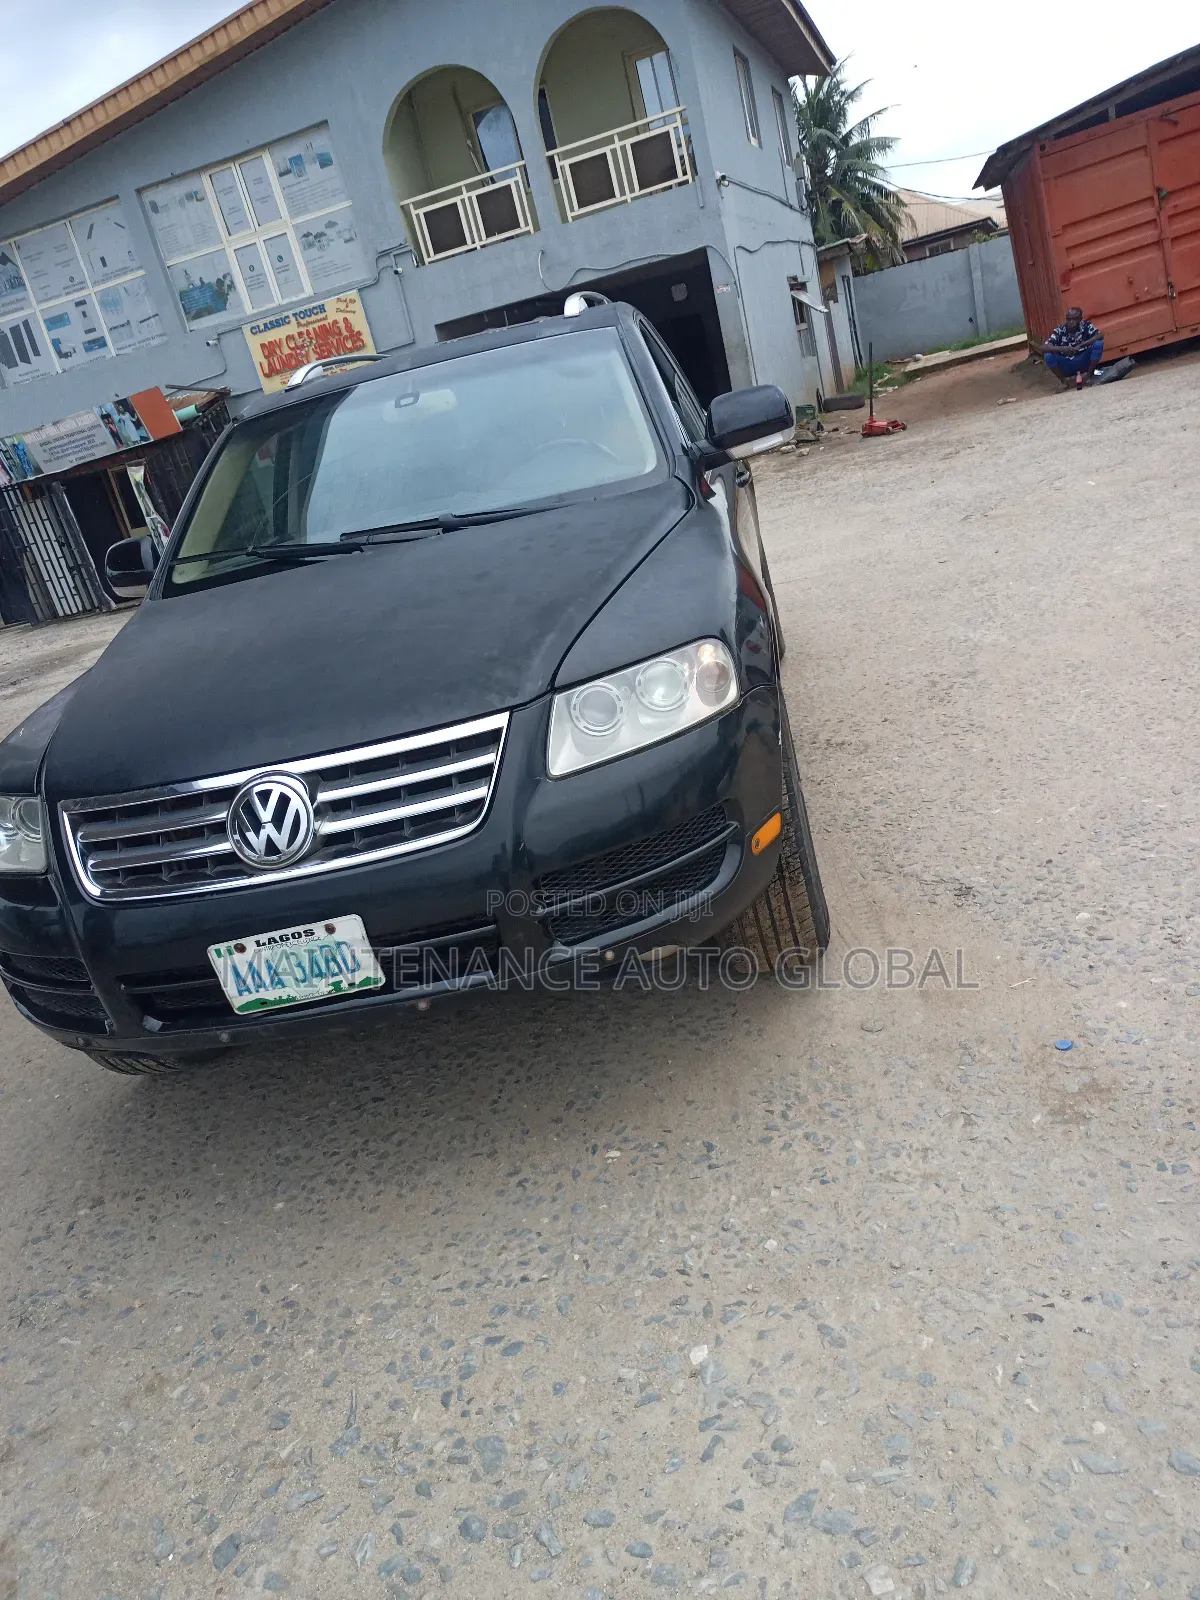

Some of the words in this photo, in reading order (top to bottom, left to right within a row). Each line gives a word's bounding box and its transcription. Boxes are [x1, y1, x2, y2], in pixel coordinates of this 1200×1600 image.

[250, 315, 291, 335] CLASSIC
[292, 304, 327, 321] TOUCH
[296, 315, 328, 328] Professional
[260, 338, 283, 359] DRY
[285, 319, 343, 351] CLEANING
[343, 316, 354, 334] &
[259, 348, 311, 378] LAUNDRY
[312, 330, 366, 361] SERVICES
[254, 929, 315, 947] LAGOS
